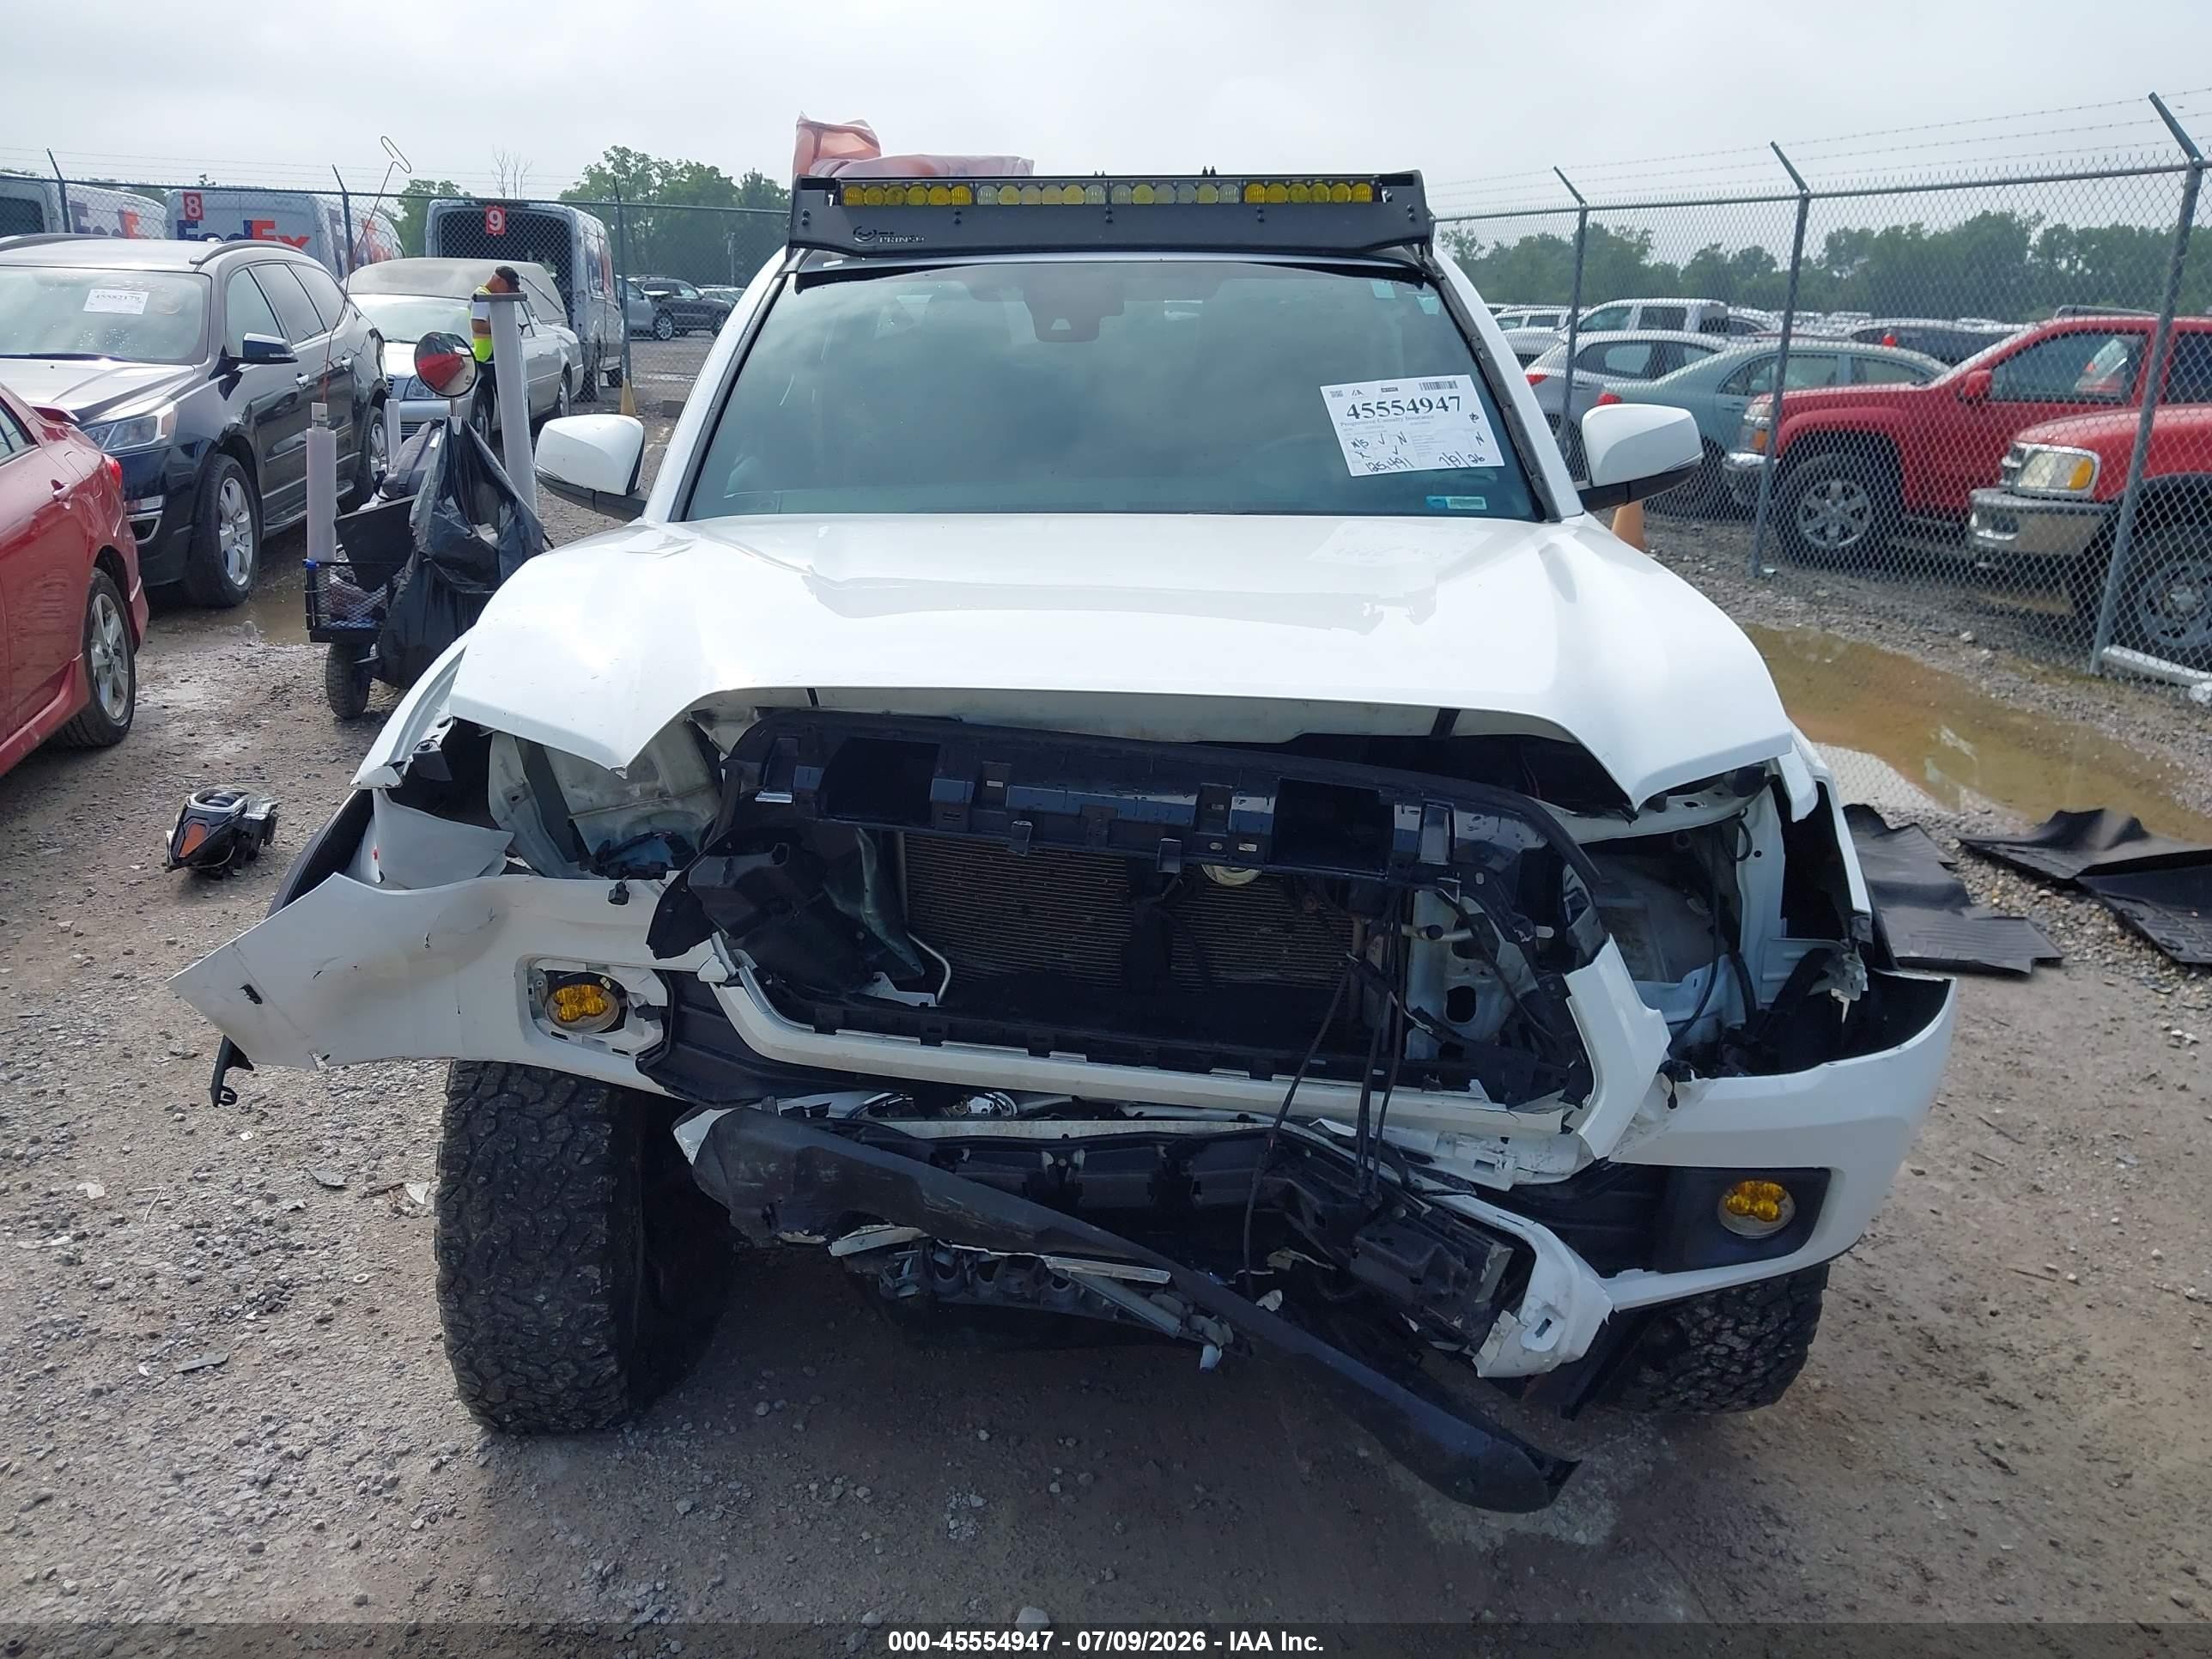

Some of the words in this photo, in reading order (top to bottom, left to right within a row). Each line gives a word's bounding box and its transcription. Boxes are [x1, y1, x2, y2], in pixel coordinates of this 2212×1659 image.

[185, 195, 202, 217] 8
[488, 210, 503, 231] 9
[1346, 396, 1462, 419] 45554947
